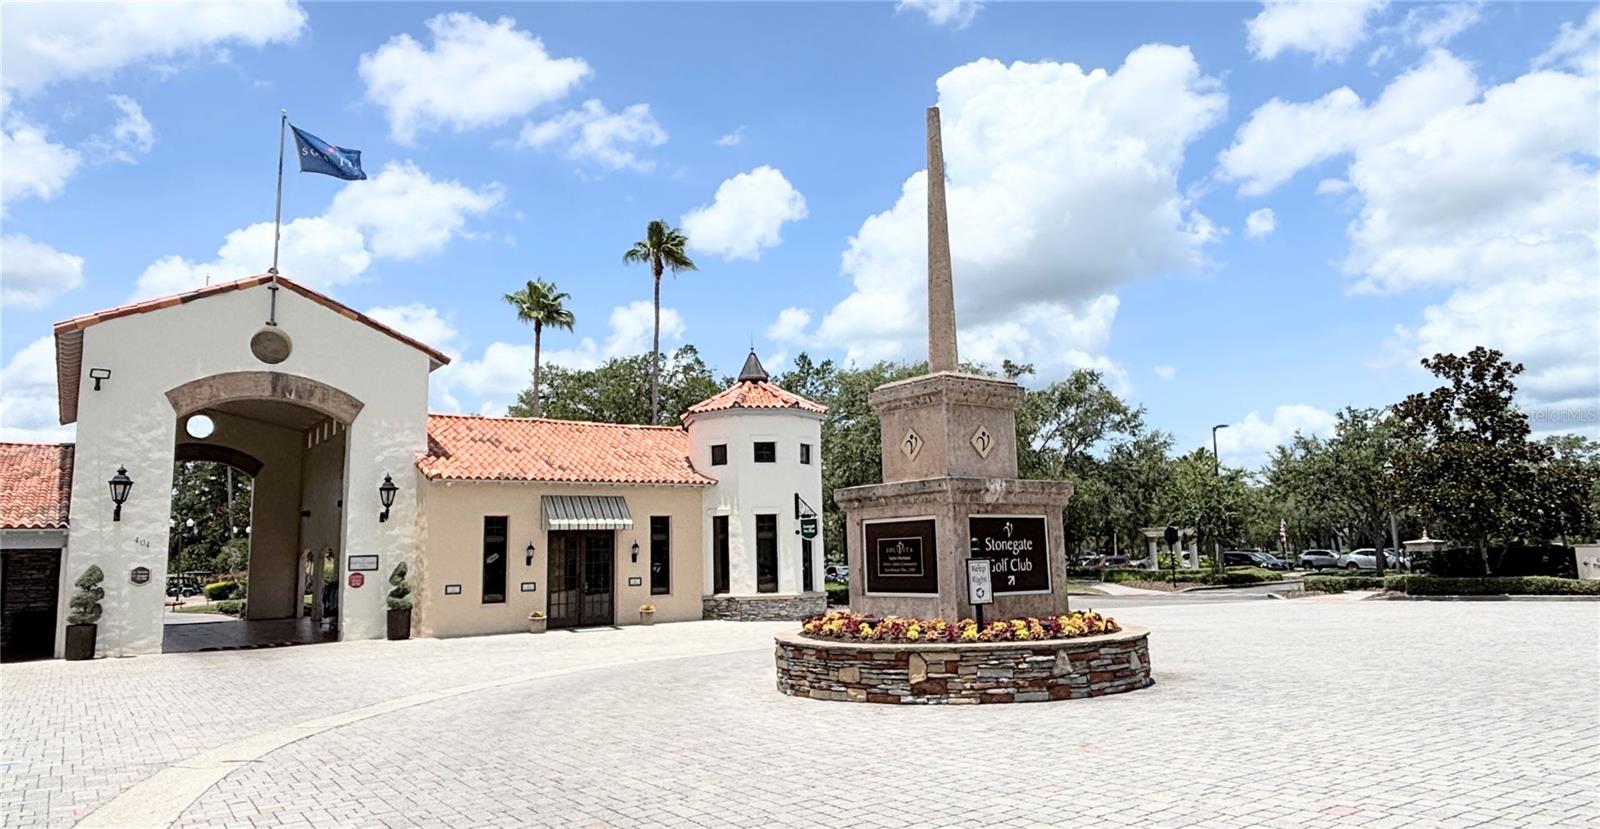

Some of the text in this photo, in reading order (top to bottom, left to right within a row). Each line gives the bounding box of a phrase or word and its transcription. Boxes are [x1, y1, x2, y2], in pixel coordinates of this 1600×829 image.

[985, 537, 1033, 555] Stonegate
[971, 565, 986, 573] Keep
[1010, 557, 1033, 571] Club
[972, 575, 987, 585] Right
